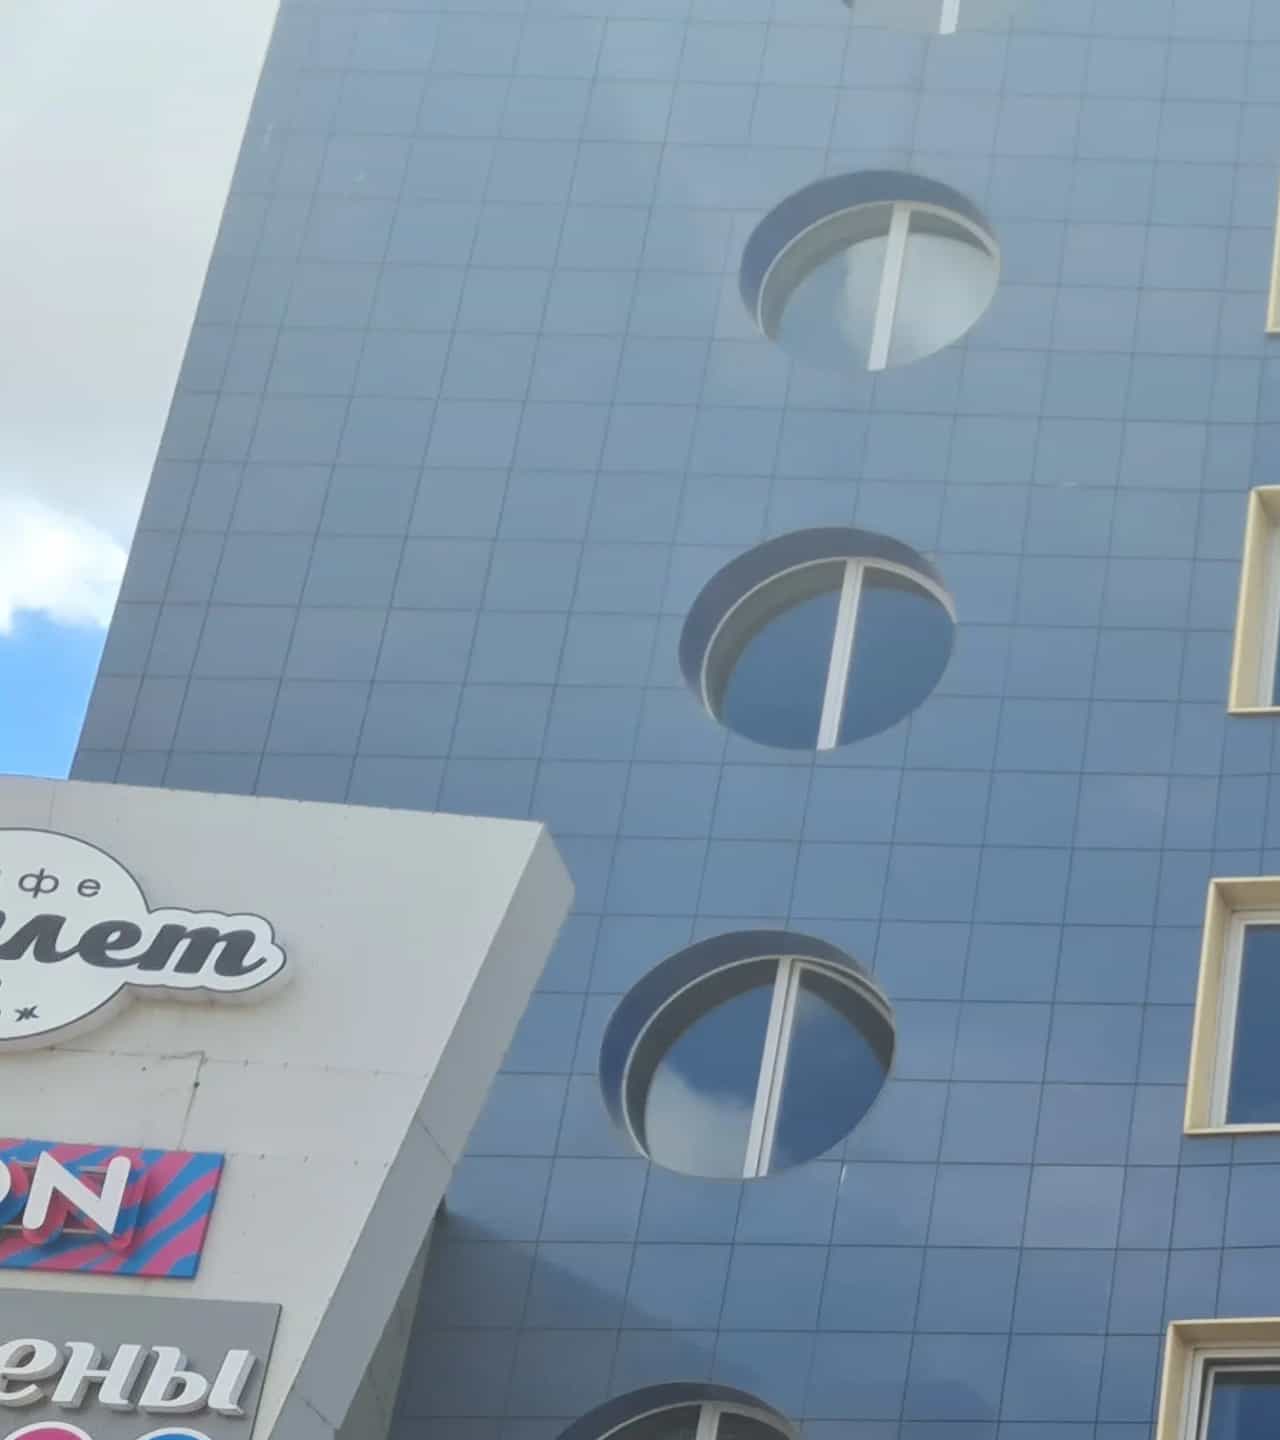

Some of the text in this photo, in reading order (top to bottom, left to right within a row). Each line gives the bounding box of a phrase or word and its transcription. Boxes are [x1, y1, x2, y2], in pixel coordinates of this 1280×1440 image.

[0, 868, 102, 898] фе
[0, 910, 267, 977] лет
[0, 1150, 132, 1235] N
